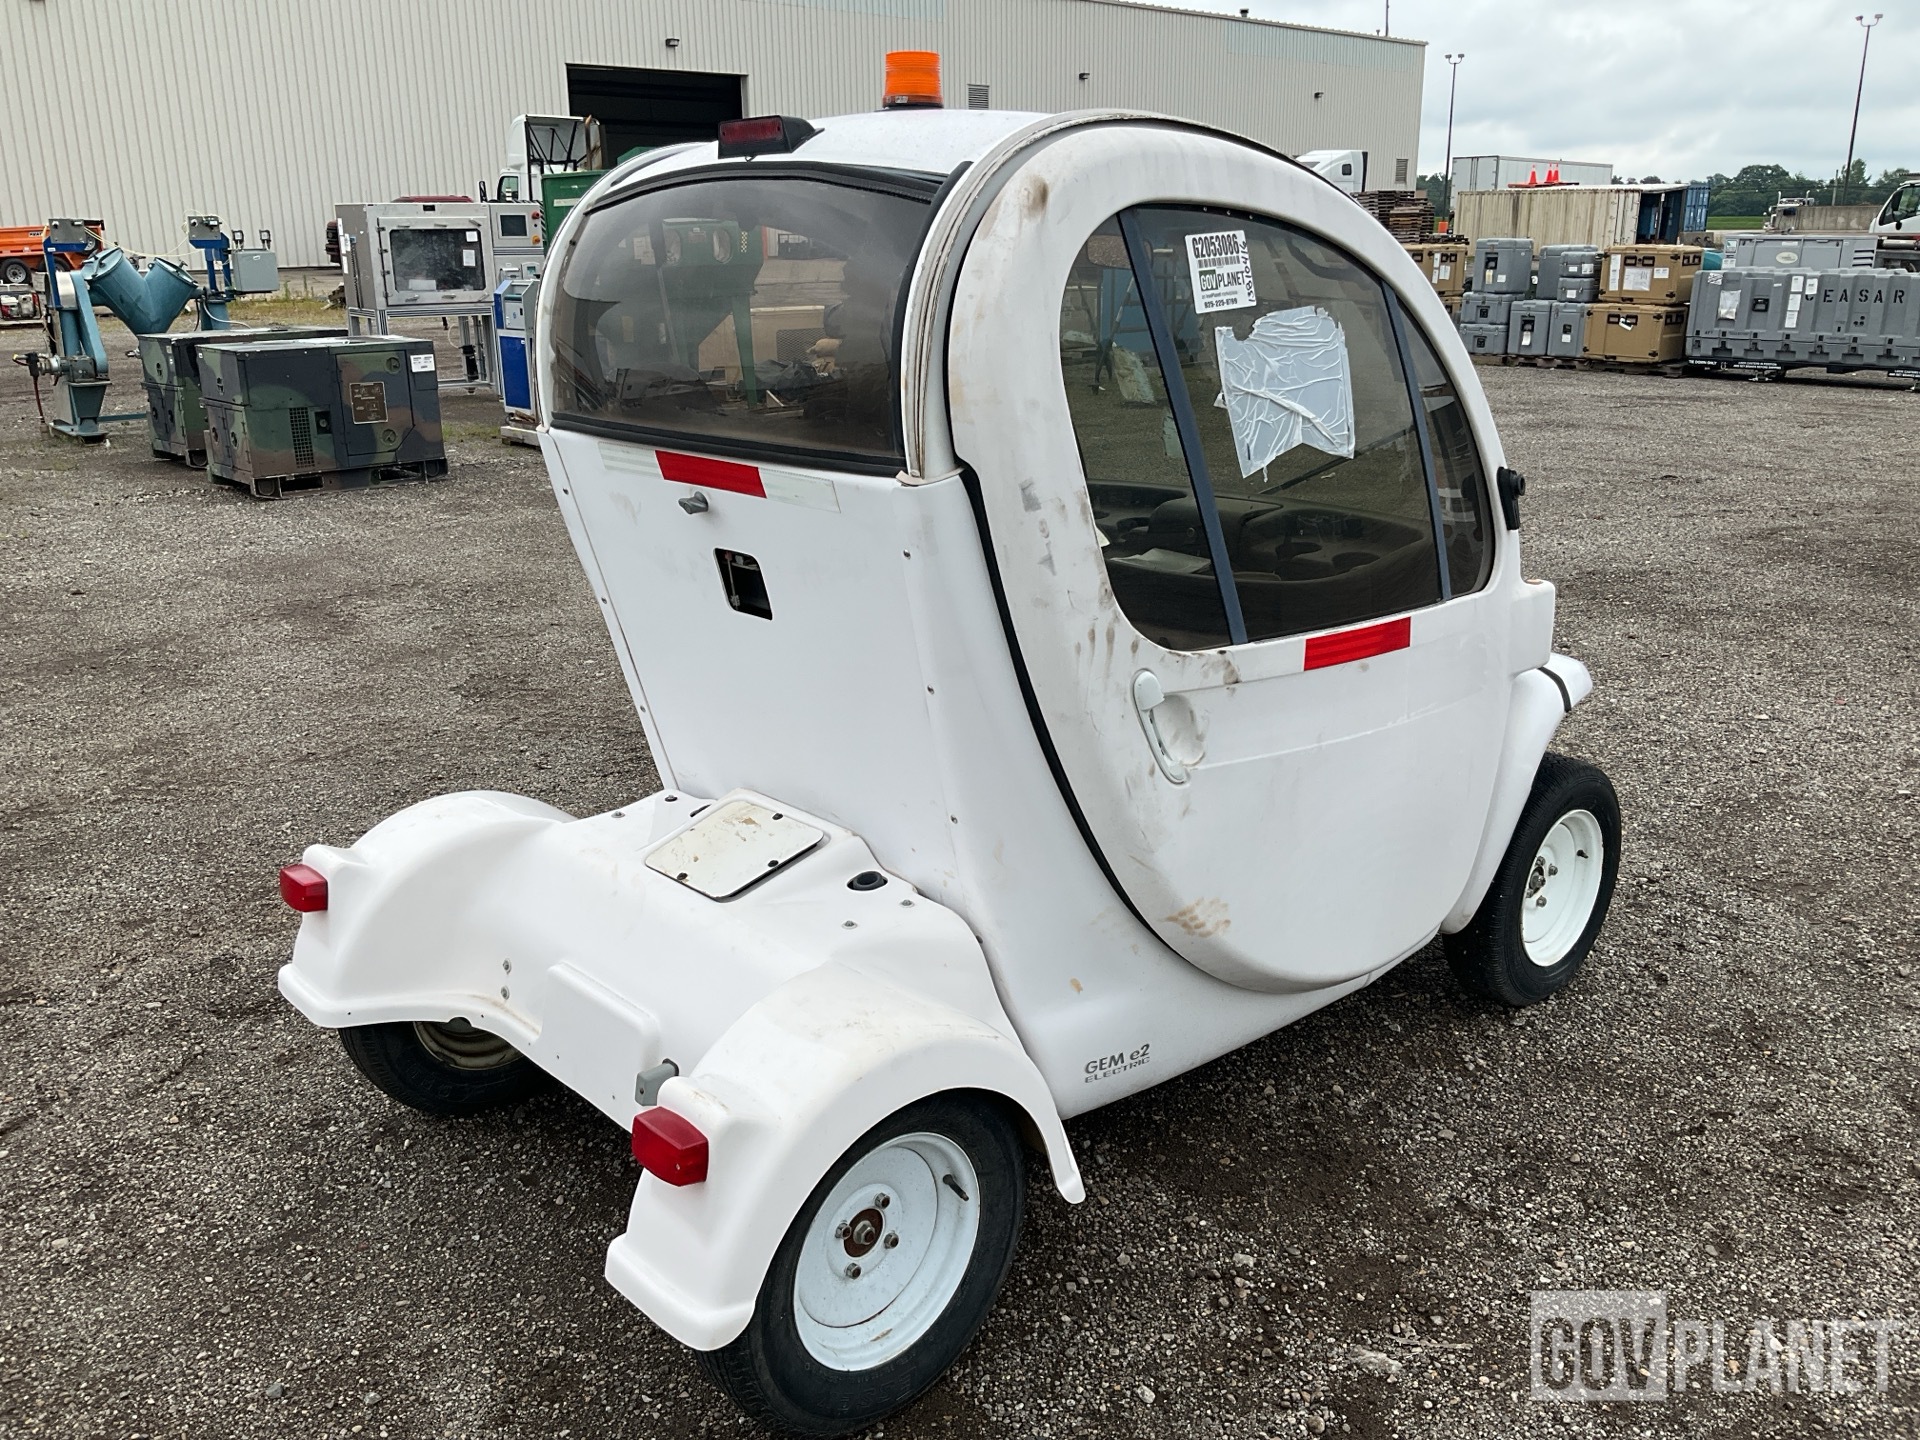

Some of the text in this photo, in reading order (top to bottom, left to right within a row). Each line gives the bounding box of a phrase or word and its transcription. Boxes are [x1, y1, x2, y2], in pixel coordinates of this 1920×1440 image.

[1191, 233, 1240, 259] G2053086
[1084, 1043, 1150, 1074] GEM e2
[1084, 1056, 1151, 1083] ELECTRIC
